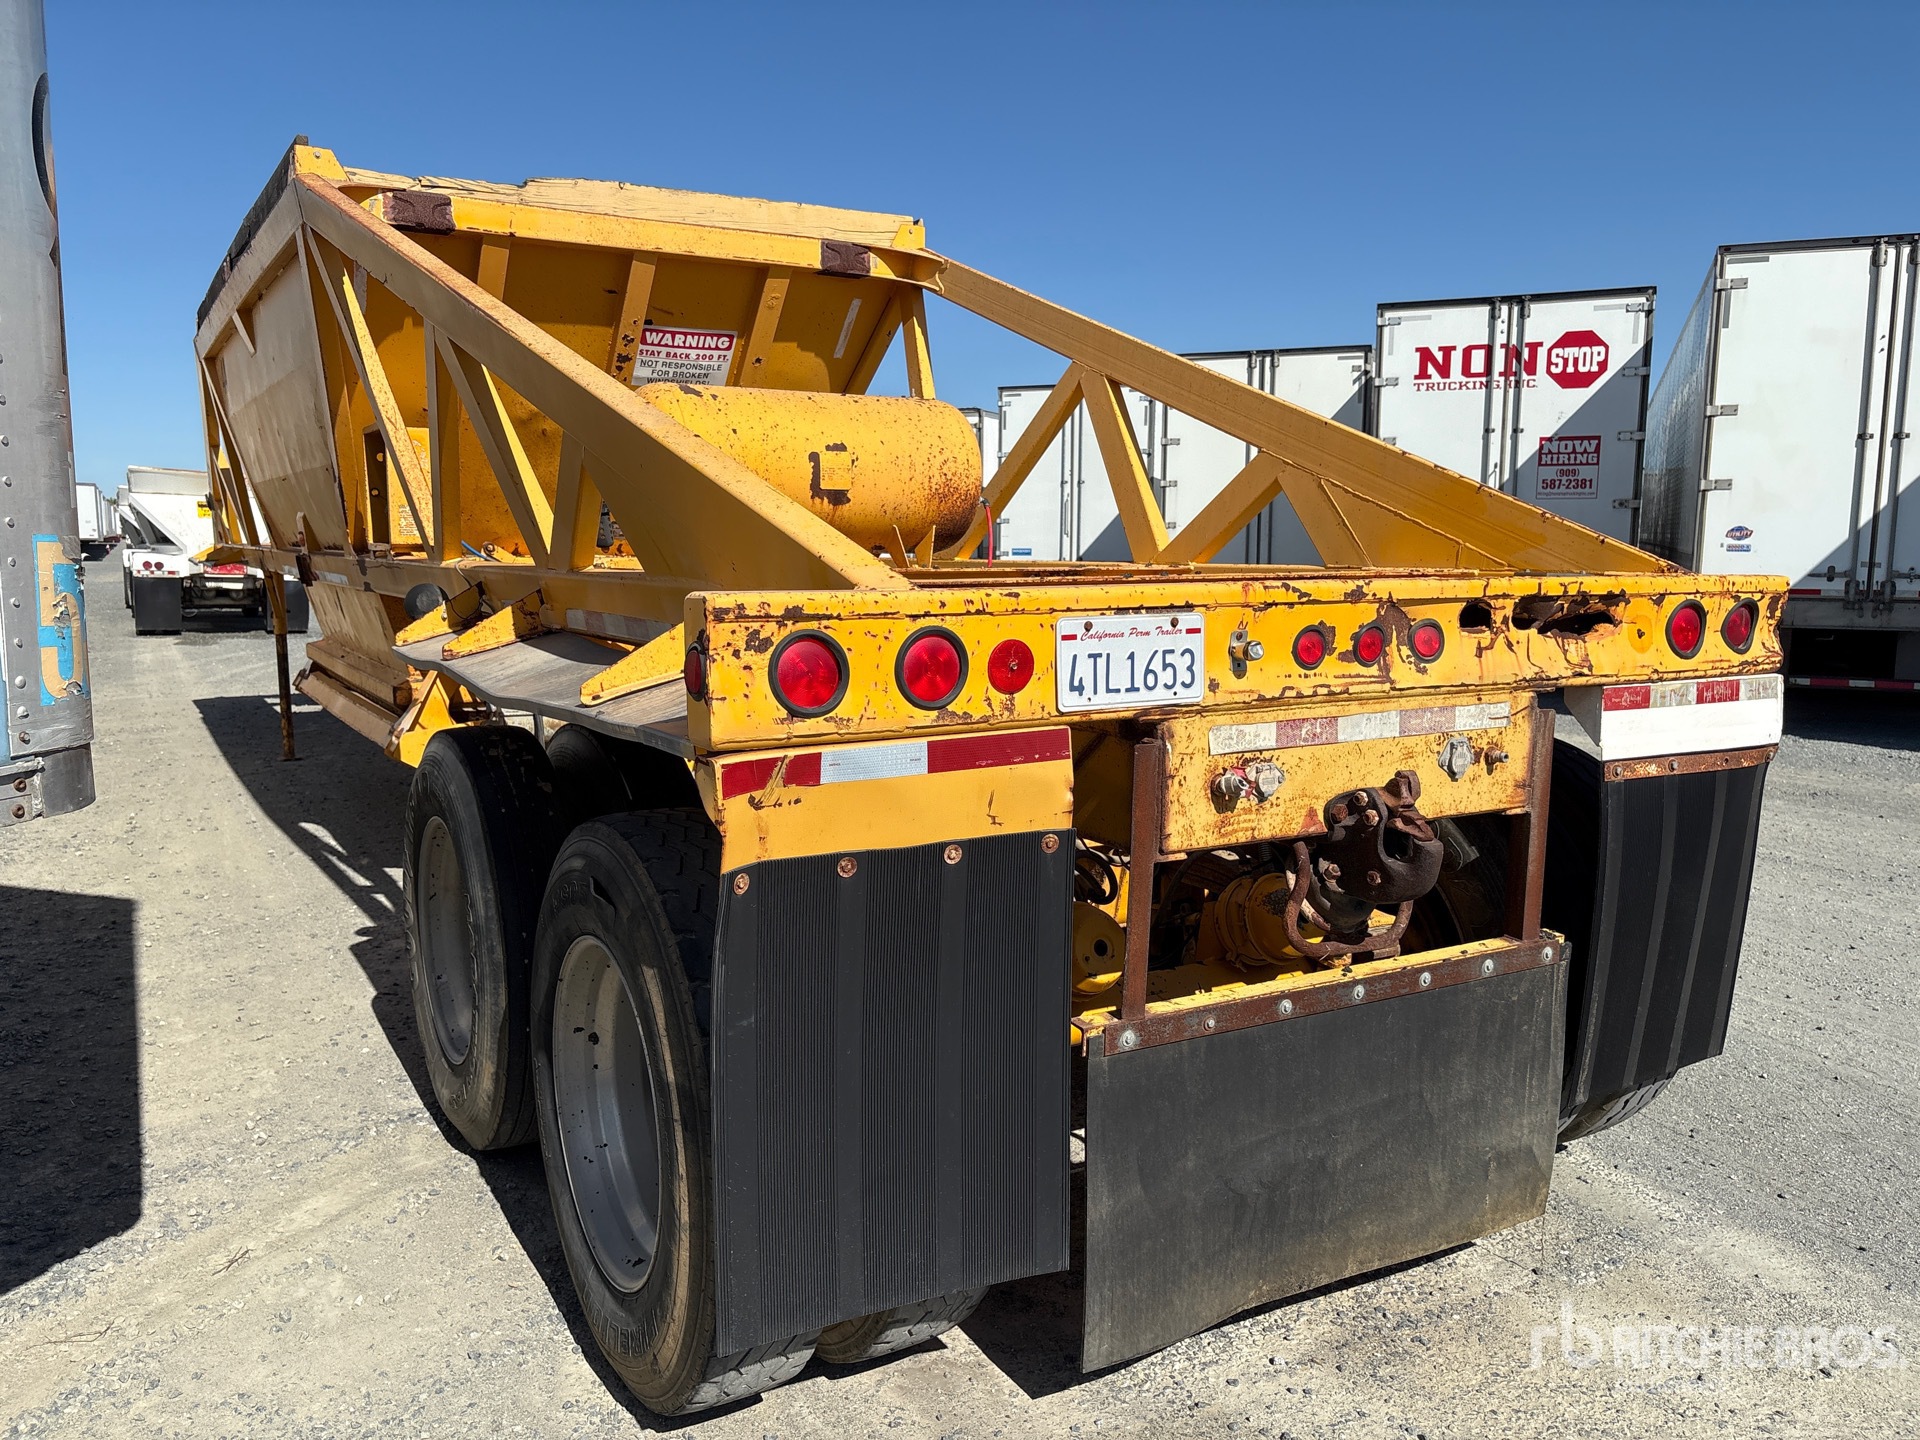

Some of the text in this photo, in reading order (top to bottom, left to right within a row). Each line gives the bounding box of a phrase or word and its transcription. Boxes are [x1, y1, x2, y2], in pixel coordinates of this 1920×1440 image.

[645, 331, 731, 349] WARNING
[638, 348, 663, 357] STAY
[665, 351, 691, 360] BACK
[695, 353, 714, 361] 200
[1413, 341, 1606, 380] NON STOP
[639, 359, 723, 372] NOT RESPONSIBLE
[650, 369, 711, 379] FOR BROKEN
[1541, 440, 1599, 453] NOW
[1541, 453, 1598, 465] HIRING
[1555, 467, 1580, 478] (909)
[1541, 478, 1594, 490] 587-2381
[1080, 625, 1183, 643] California Perm Trailer
[1068, 647, 1196, 697] 4TL1653
